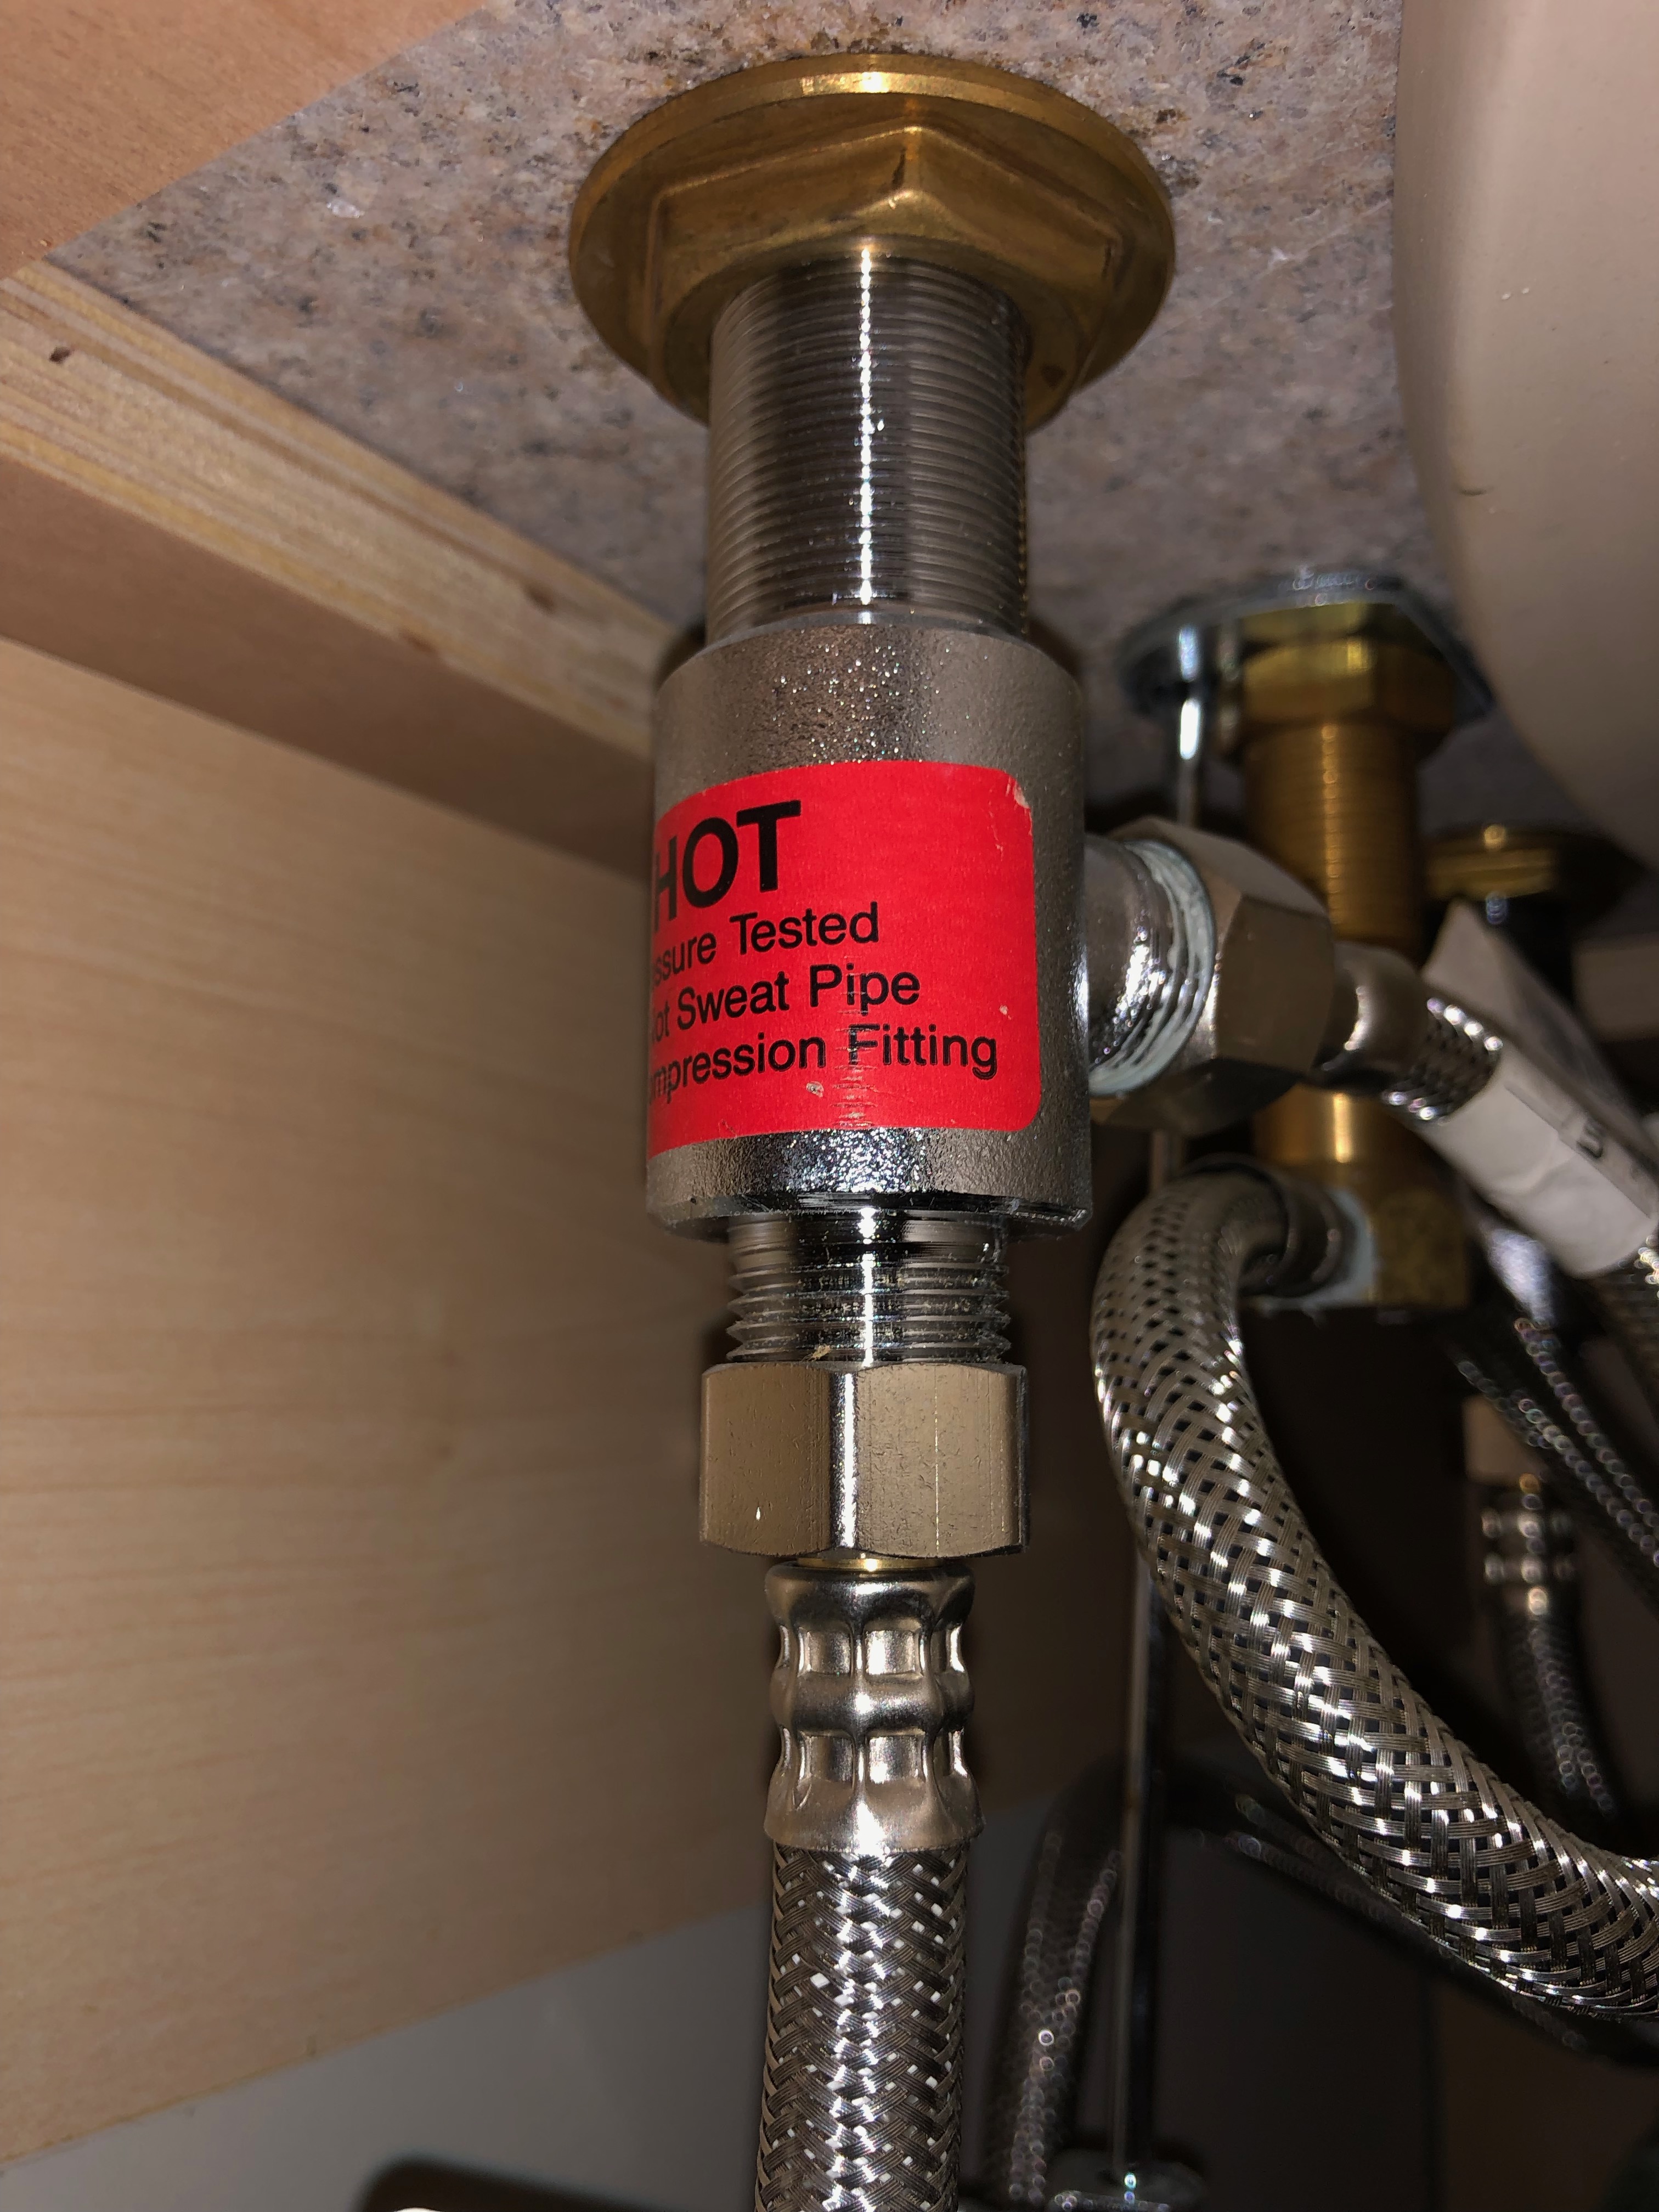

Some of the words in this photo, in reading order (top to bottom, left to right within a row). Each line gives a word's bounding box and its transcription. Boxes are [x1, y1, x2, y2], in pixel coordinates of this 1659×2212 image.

[654, 799, 802, 934] HOT
[653, 932, 717, 988] ssure
[729, 901, 878, 955] Tested
[652, 1001, 670, 1044] ot
[677, 970, 790, 1030] Sweat
[809, 963, 921, 1016] Pipe
[650, 1031, 826, 1105] mpression
[848, 1023, 997, 1080] Fitting
